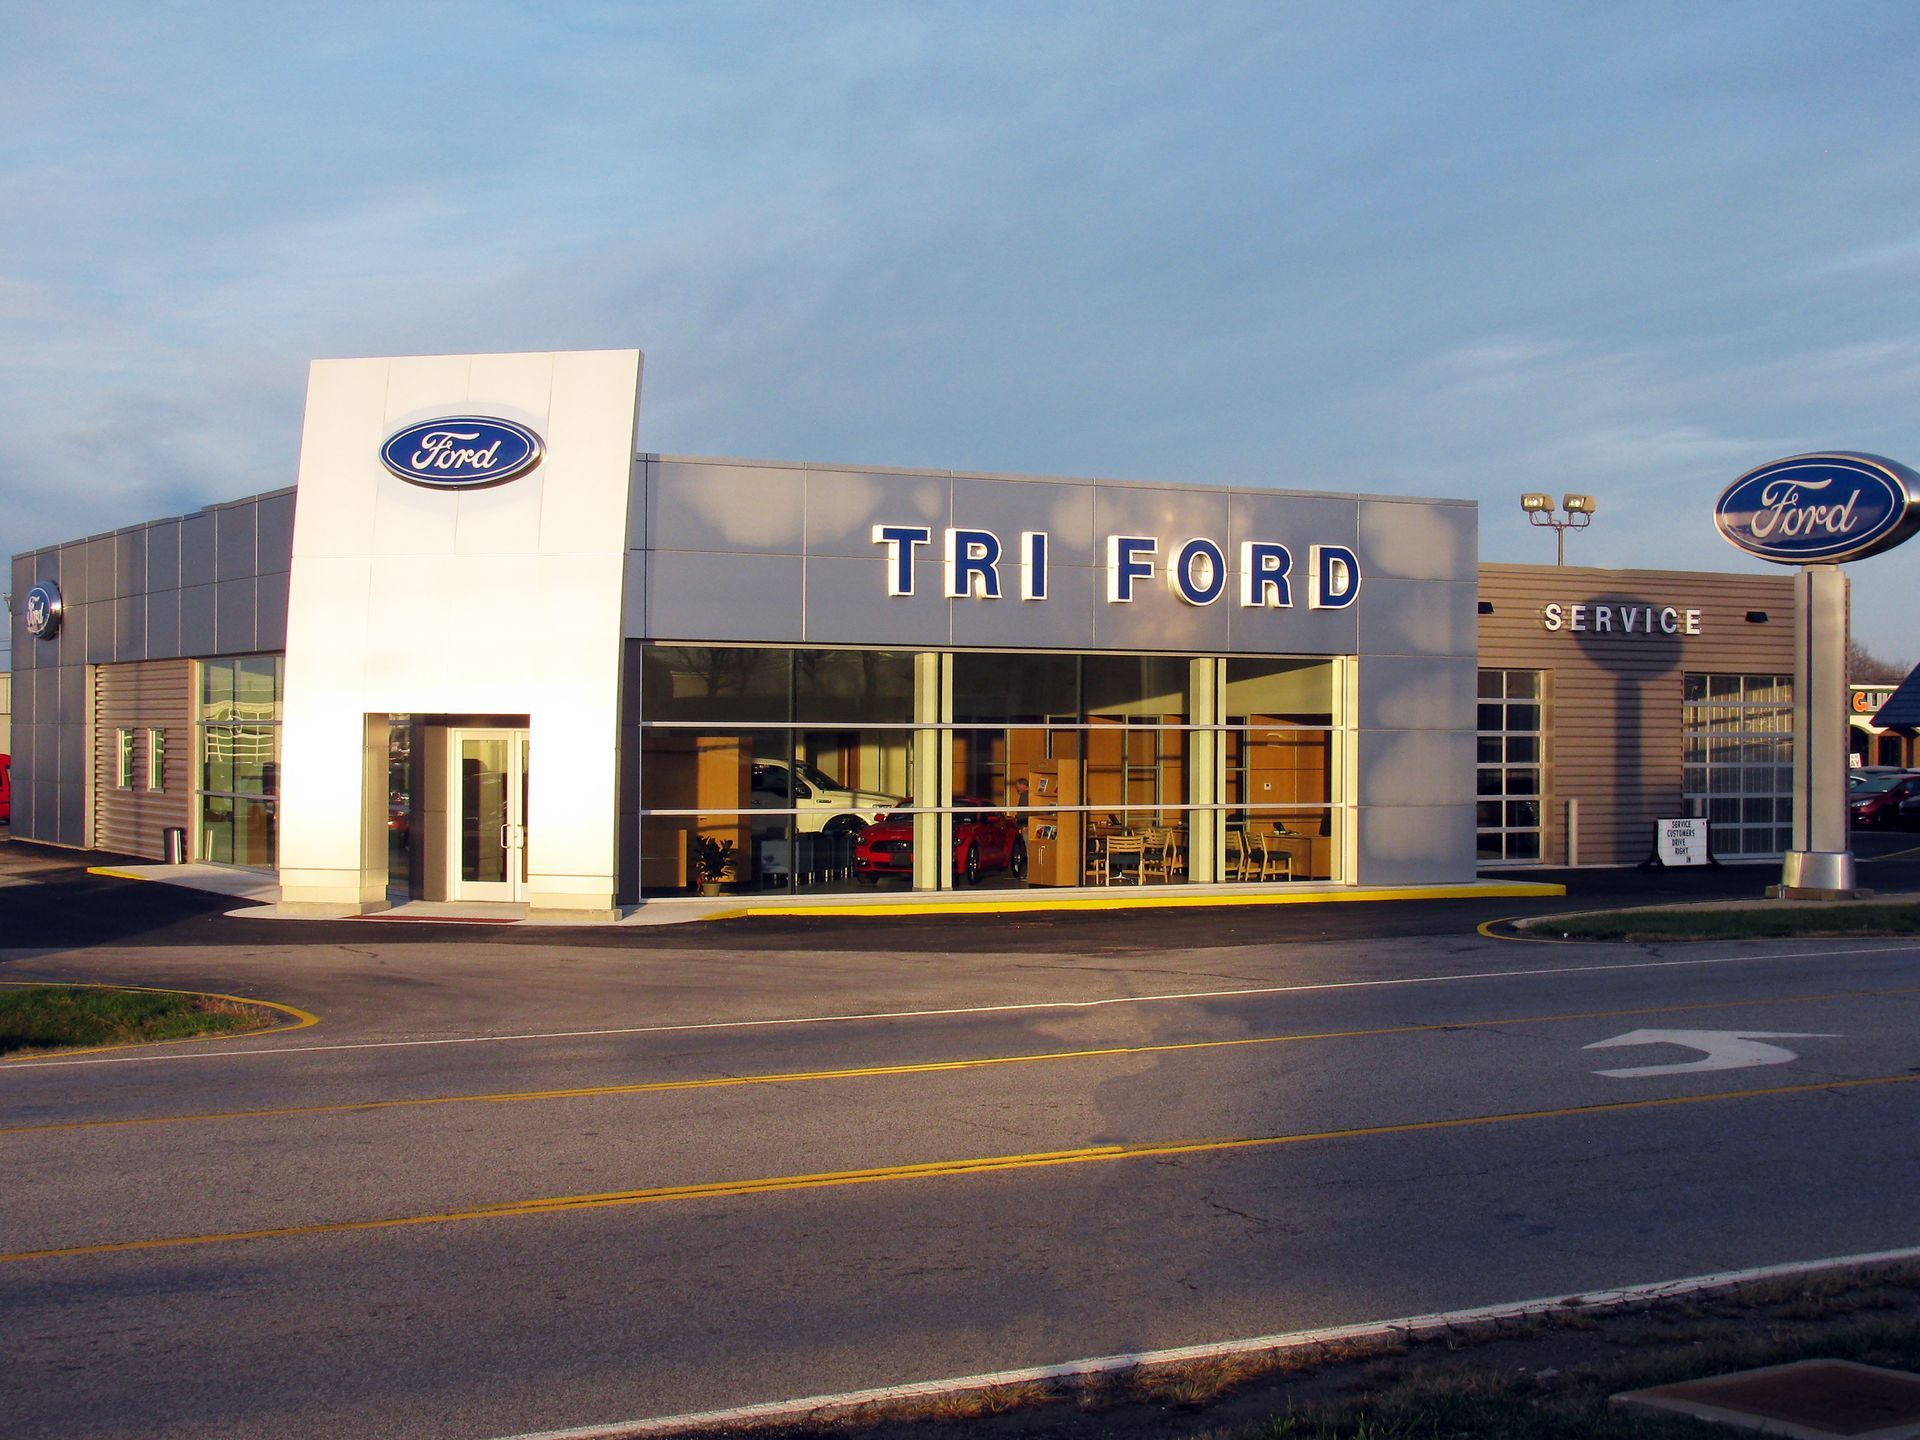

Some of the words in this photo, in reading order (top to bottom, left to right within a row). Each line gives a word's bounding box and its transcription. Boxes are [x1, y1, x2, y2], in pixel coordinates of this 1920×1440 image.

[411, 431, 502, 470] Ford
[1750, 478, 1861, 539] Ford
[872, 524, 1048, 601] TRI
[1107, 535, 1362, 610] FORD
[26, 595, 45, 627] Ford
[1544, 603, 1702, 635] SERVICE
[1666, 829, 1696, 838] CUSTOMERS
[1671, 820, 1691, 829] SERVICE
[1671, 838, 1686, 847] DRIVE
[1674, 847, 1689, 856] RIGHT
